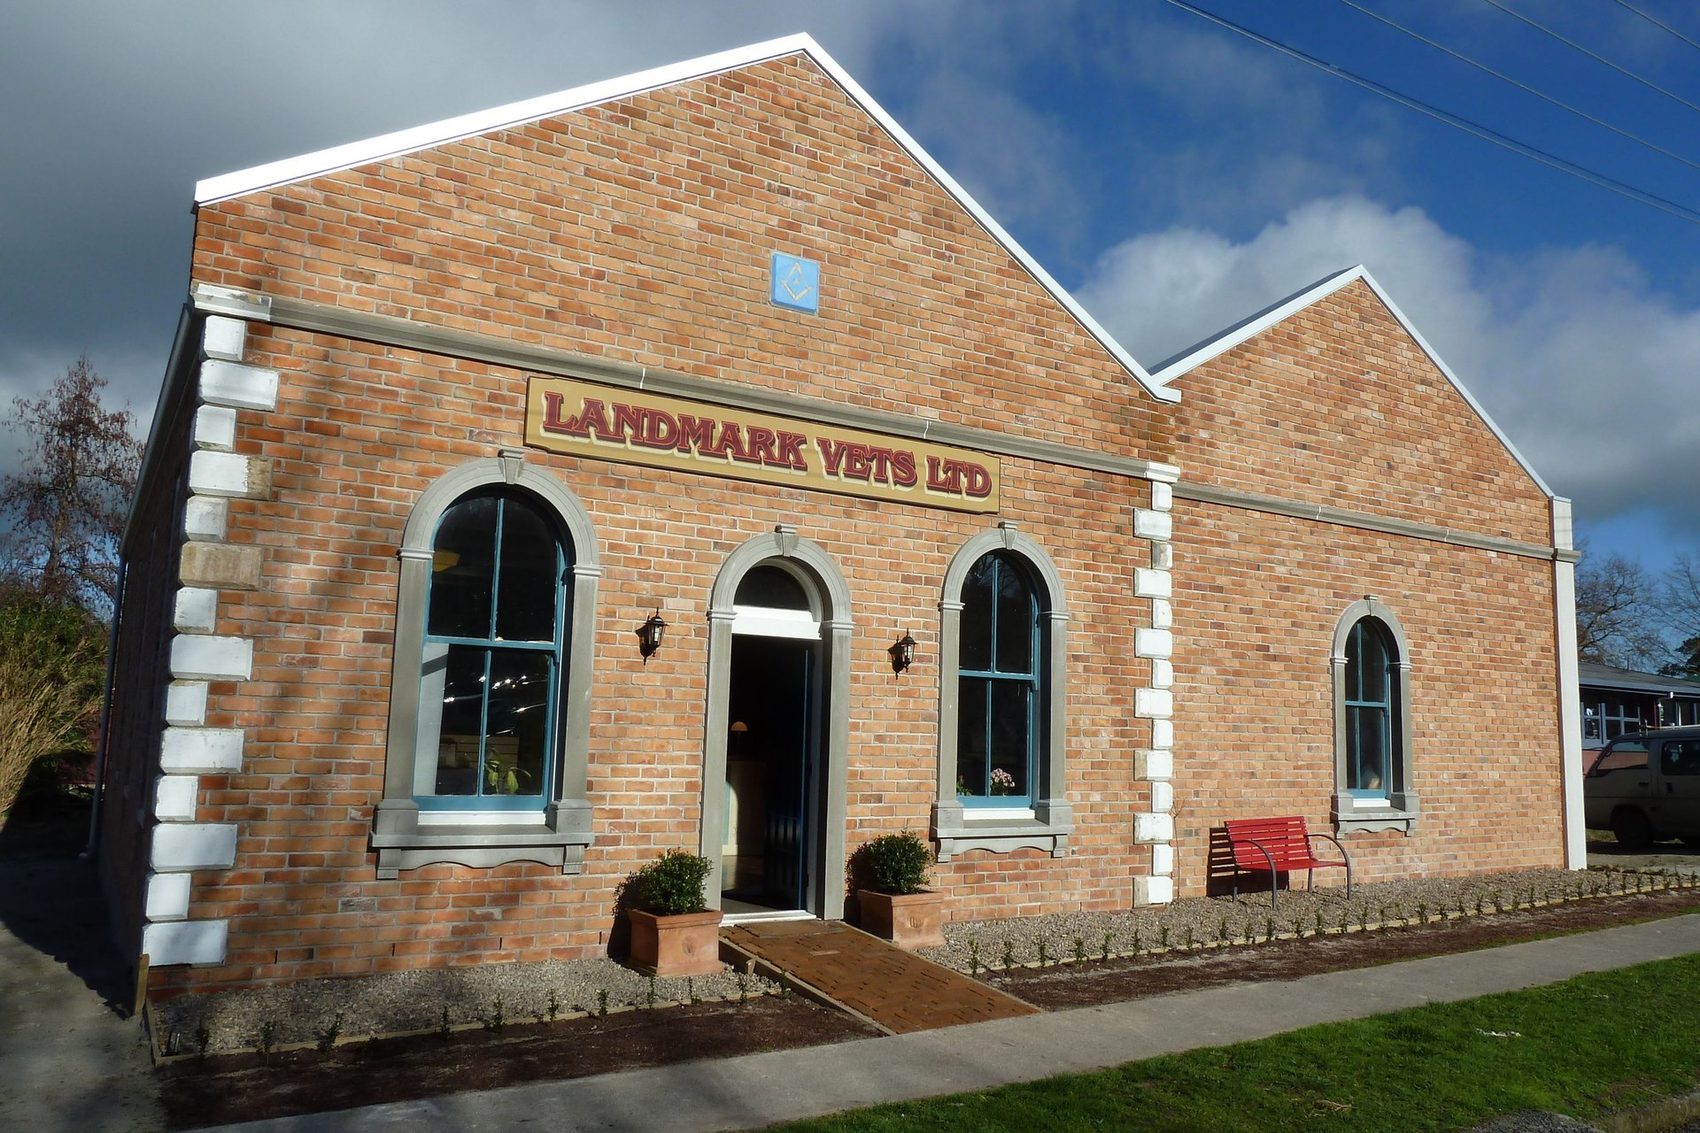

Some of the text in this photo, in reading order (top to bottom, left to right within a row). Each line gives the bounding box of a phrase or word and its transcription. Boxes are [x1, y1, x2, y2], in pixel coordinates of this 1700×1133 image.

[543, 391, 992, 498] LANDMARK VETS LTD
